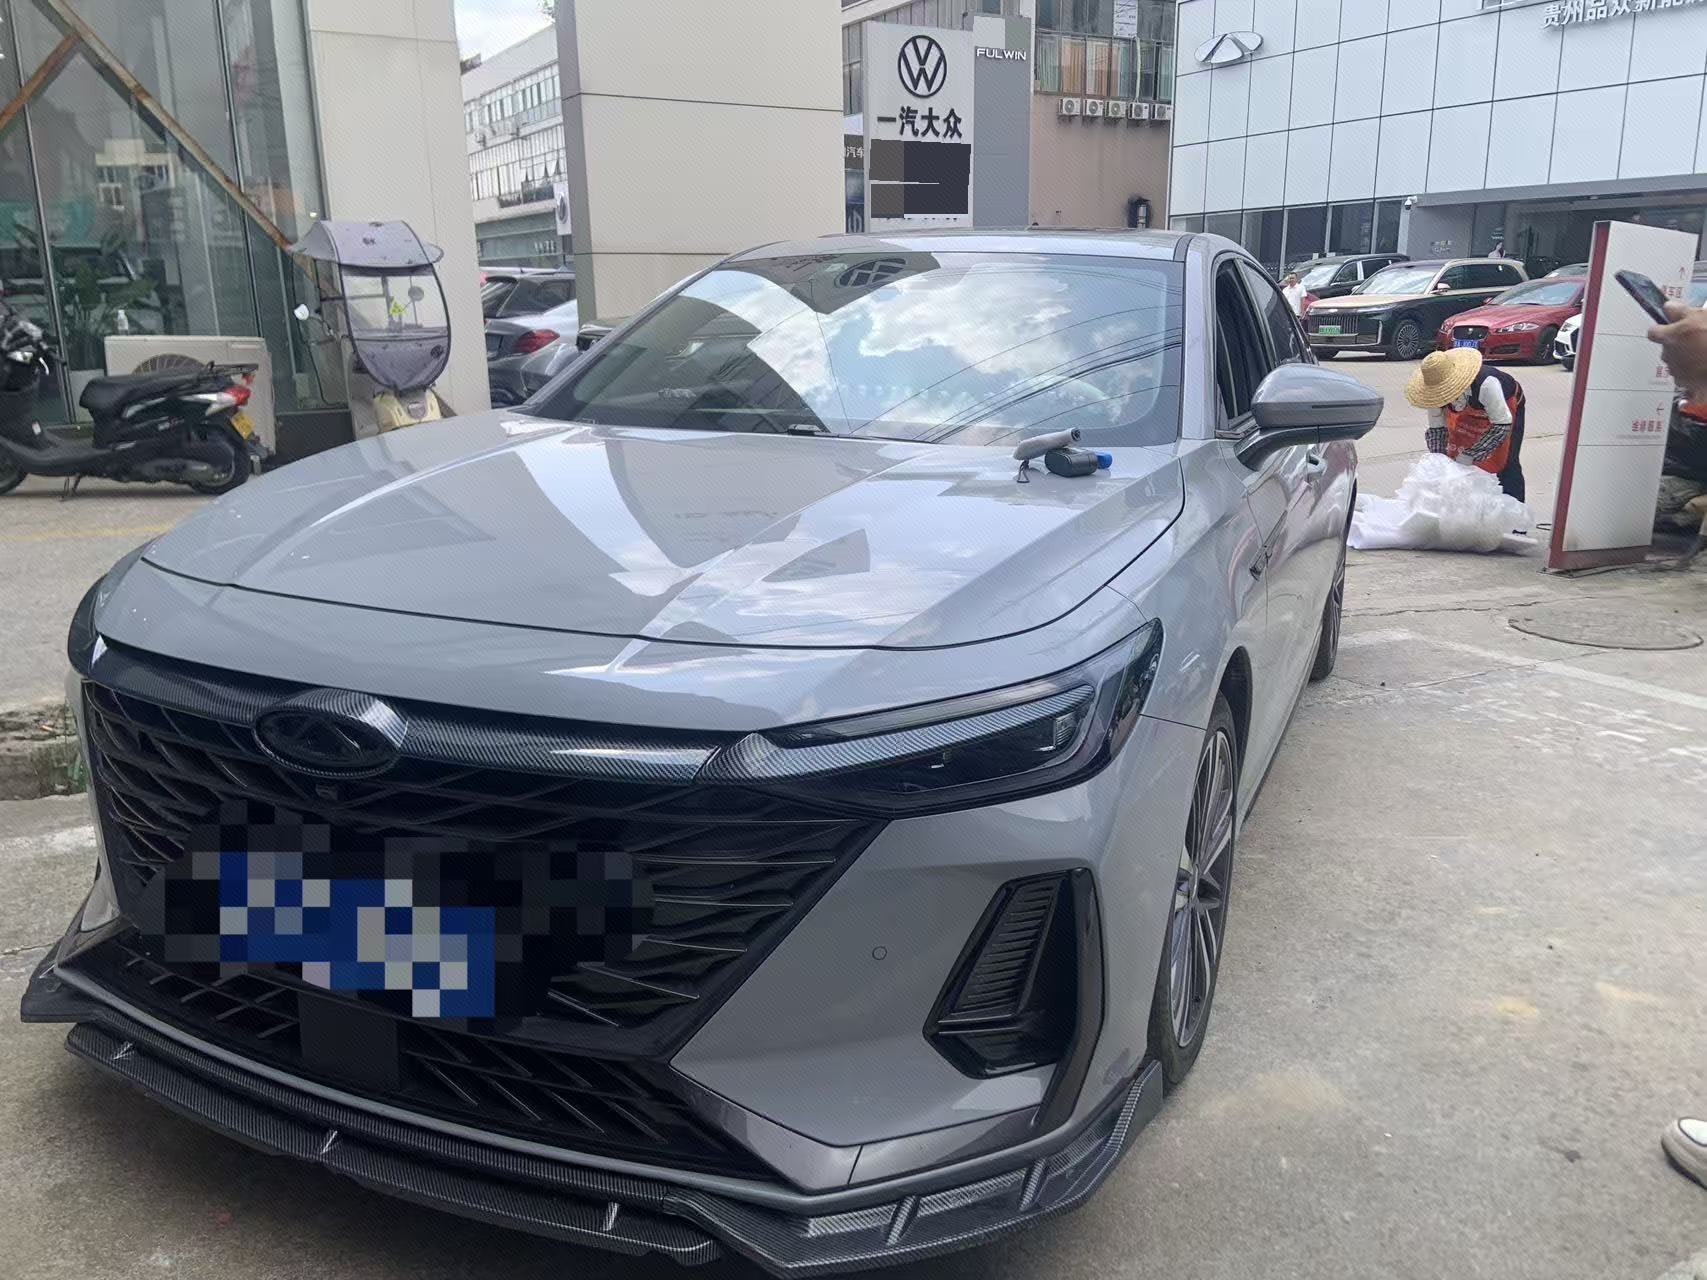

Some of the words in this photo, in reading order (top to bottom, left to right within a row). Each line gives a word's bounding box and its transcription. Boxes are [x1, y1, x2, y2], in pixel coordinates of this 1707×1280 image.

[976, 48, 1027, 61] FULWIN
[877, 106, 963, 139] 一汽大众
